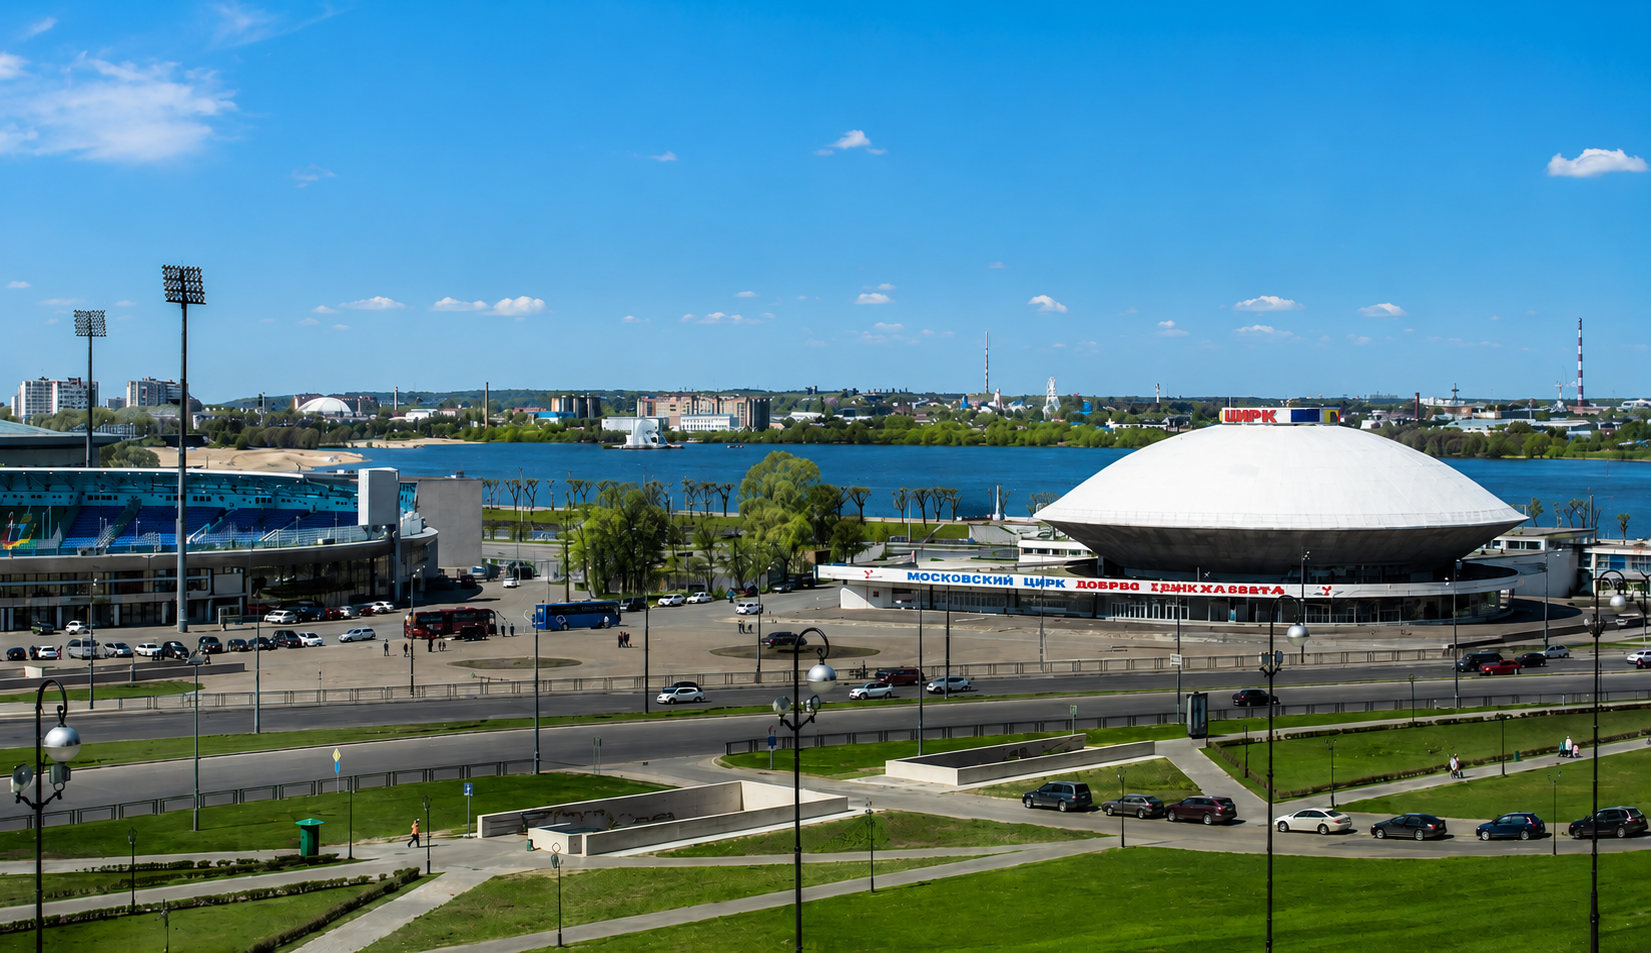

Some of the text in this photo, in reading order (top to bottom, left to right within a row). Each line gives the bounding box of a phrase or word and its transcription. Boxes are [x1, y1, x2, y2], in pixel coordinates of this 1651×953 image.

[1224, 409, 1277, 424] ЦИРК
[907, 571, 1014, 586] МОСКОВСКИЙ
[1023, 577, 1066, 588] ЦИРК
